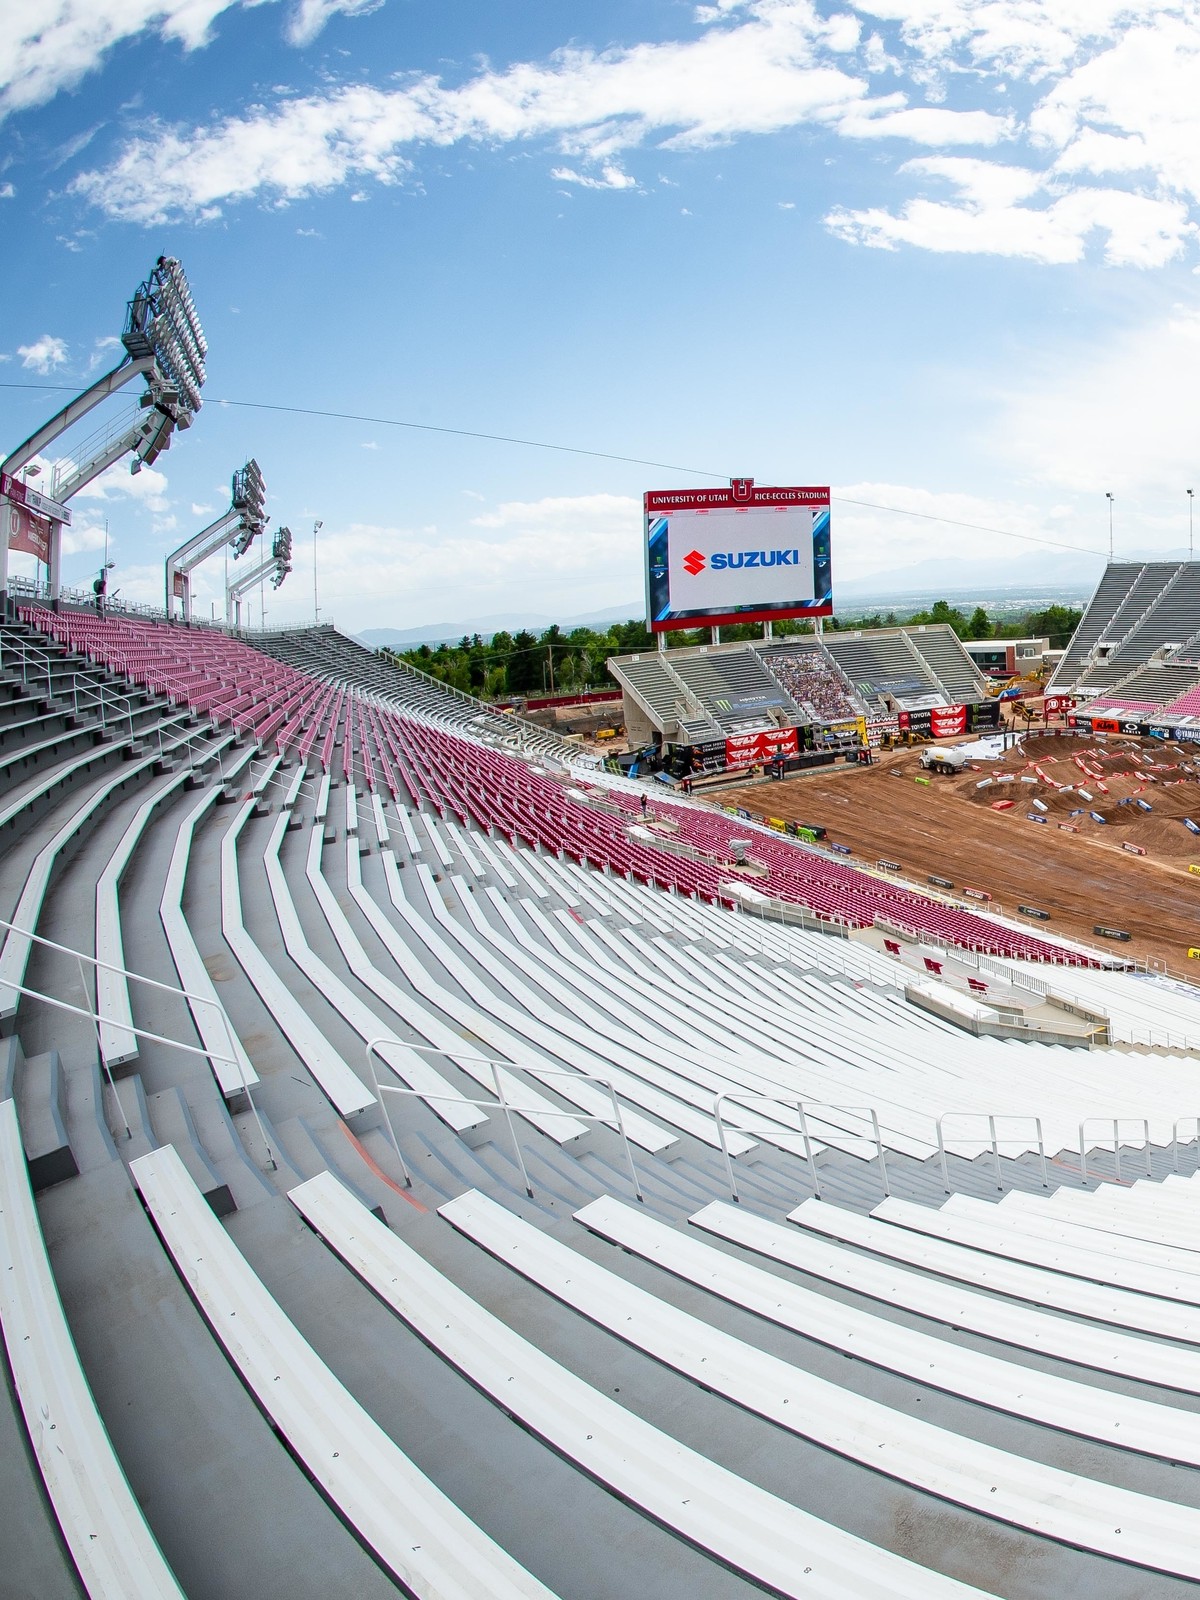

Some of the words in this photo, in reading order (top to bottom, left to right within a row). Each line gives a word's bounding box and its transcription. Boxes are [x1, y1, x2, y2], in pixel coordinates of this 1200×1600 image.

[730, 478, 754, 502] U
[652, 495, 695, 504] UNIVERSITY
[696, 494, 708, 502] OF
[709, 494, 728, 502] UTAH
[754, 492, 796, 500] RICE-ECCLES
[710, 549, 799, 570] SUZUKI
[910, 711, 931, 719] TOYOTA
[911, 722, 931, 731] TOYOTA
[1096, 722, 1114, 730] KTM
